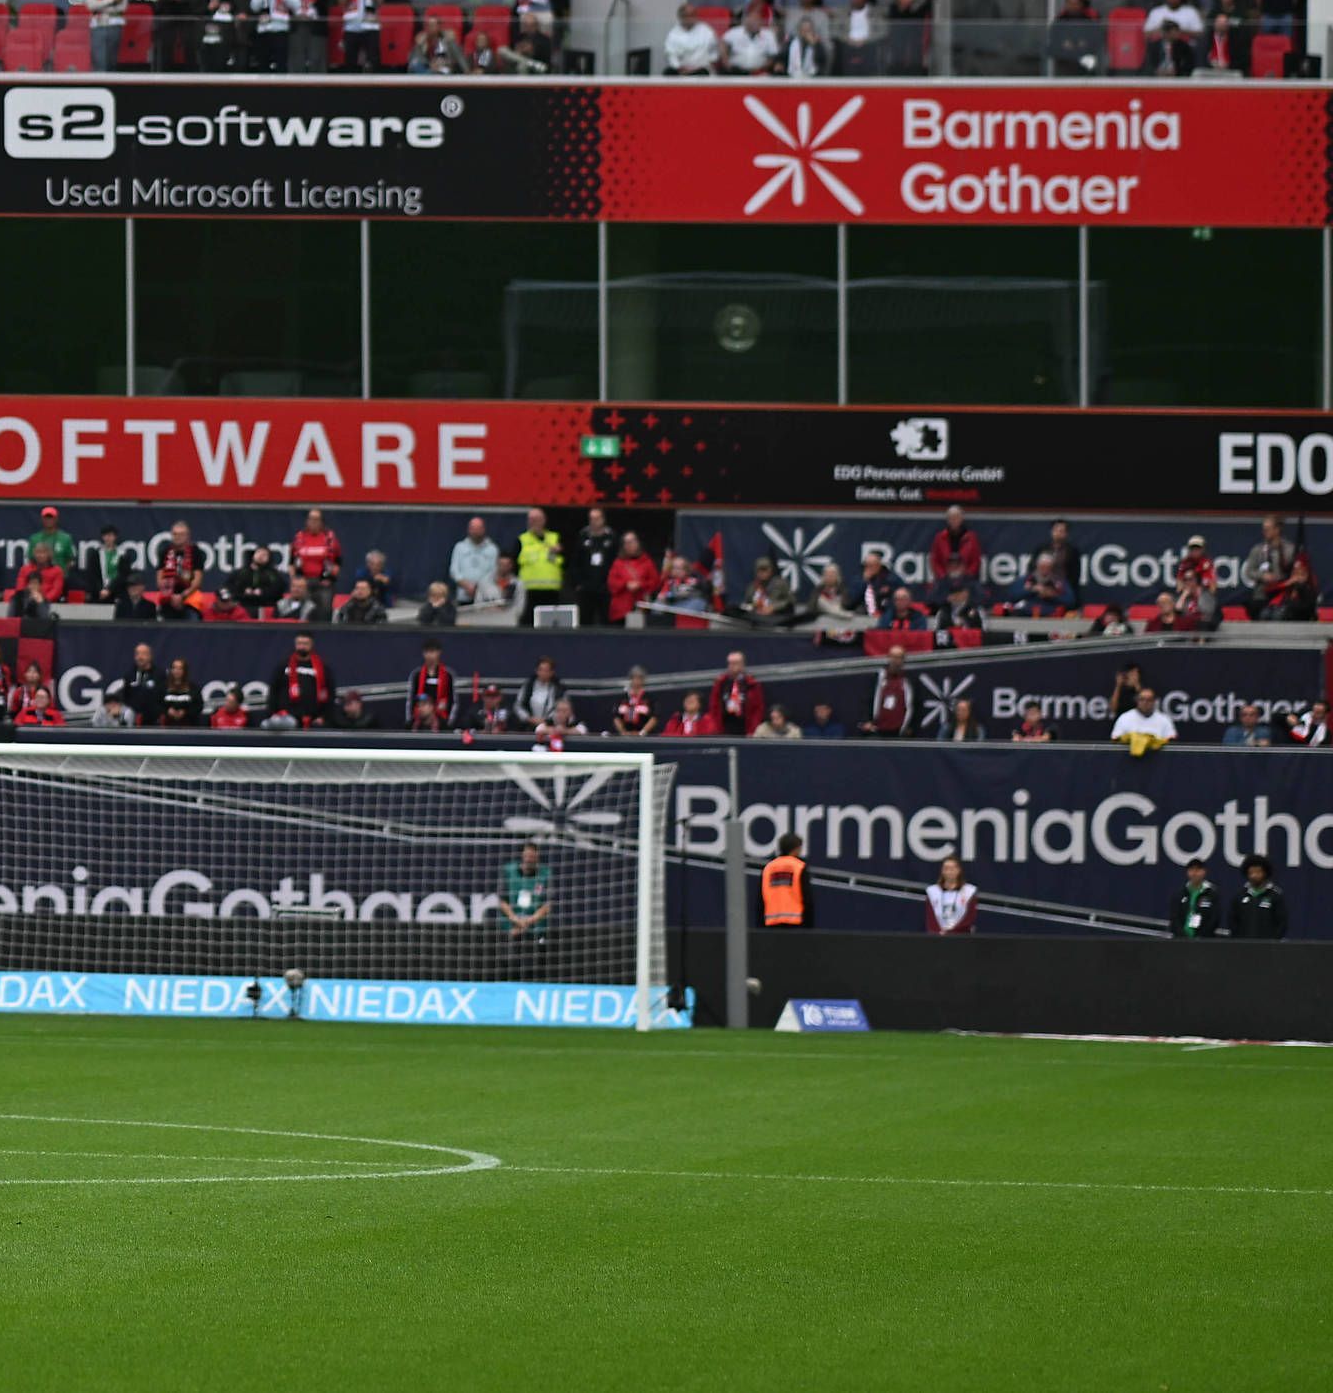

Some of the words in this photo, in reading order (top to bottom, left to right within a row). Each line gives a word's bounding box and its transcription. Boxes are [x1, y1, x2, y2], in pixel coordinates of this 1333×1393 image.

[902, 98, 1180, 151] Barmenia
[45, 177, 121, 208] Used
[131, 178, 274, 209] Microsoft
[284, 180, 423, 215] Licensing
[900, 162, 1139, 215] Gothaer
[834, 465, 861, 480] EDO
[864, 465, 960, 482] Personalservice
[962, 466, 1004, 482] GmbH
[1219, 432, 1333, 496] EDO
[124, 977, 290, 1012] NIEDAX
[309, 984, 478, 1020] NIEDAX
